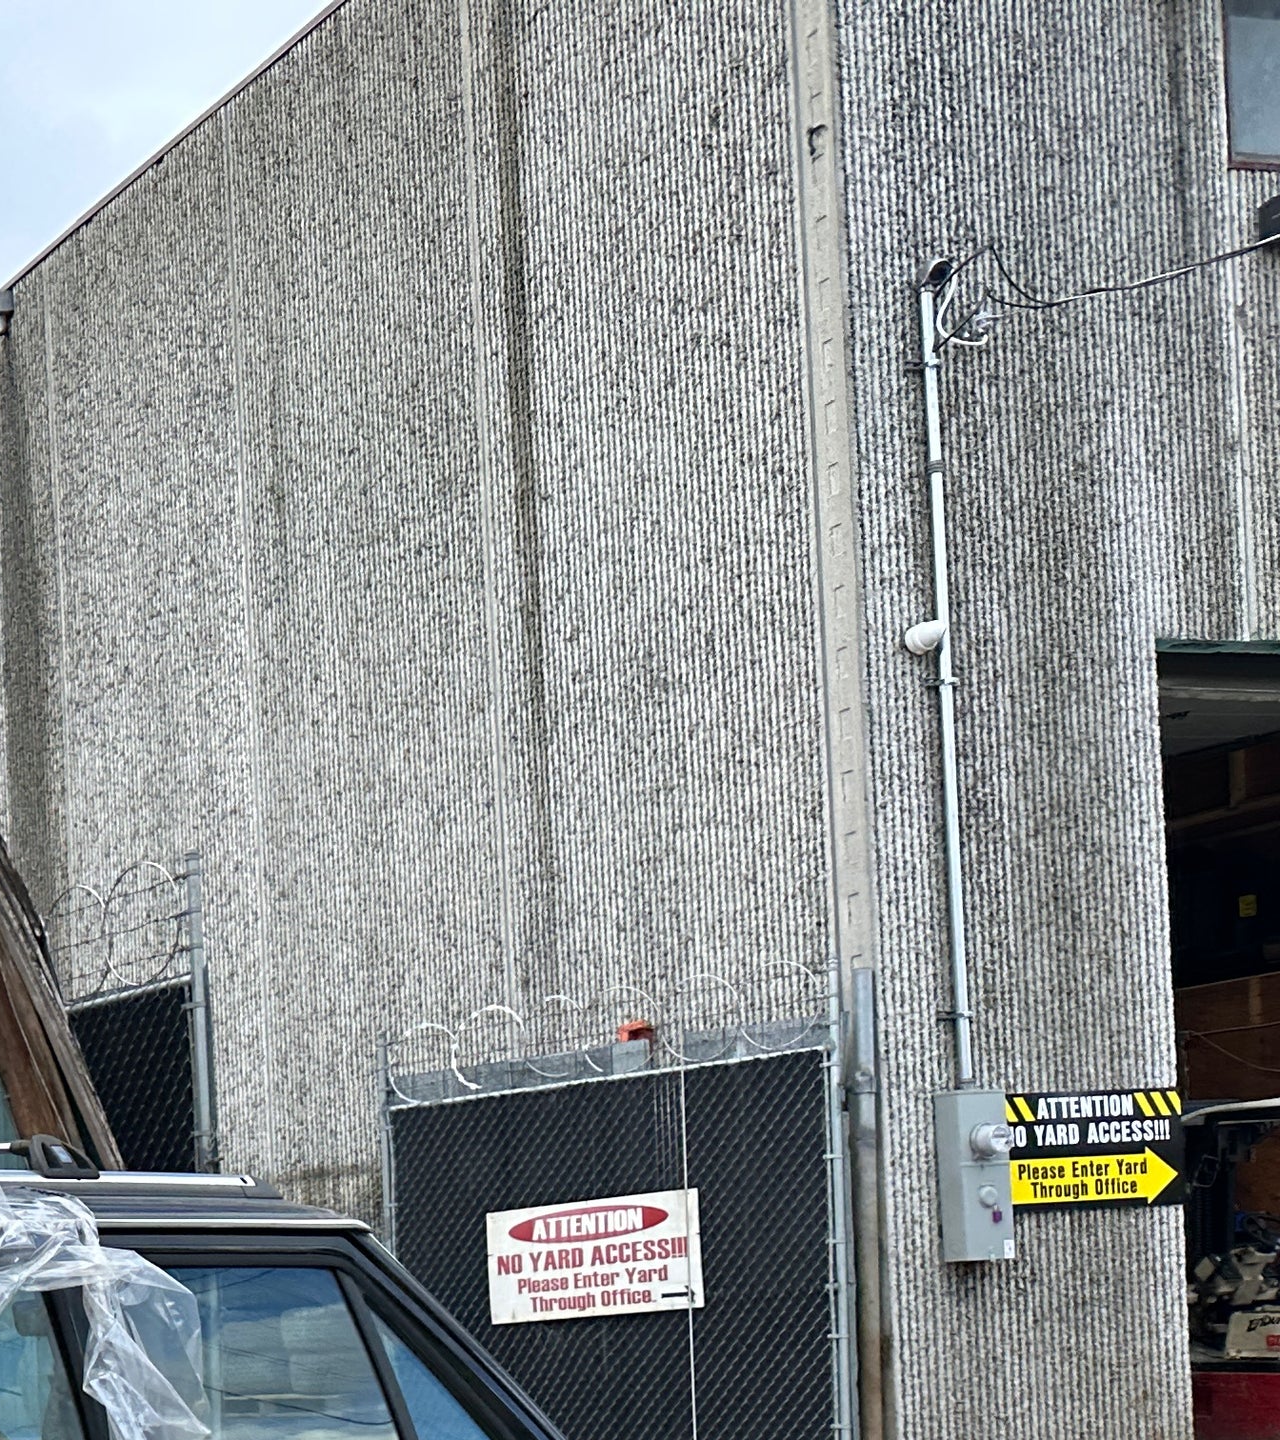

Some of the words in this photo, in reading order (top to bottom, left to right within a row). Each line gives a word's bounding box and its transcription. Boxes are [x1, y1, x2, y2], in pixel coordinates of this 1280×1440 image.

[1036, 1094, 1134, 1120] ATTENTION
[1034, 1123, 1080, 1147] YARD
[1087, 1118, 1171, 1145] ACCESS!!!
[1017, 1162, 1066, 1181] Please
[1072, 1160, 1110, 1178] Enter
[1116, 1158, 1147, 1176] Yard
[1030, 1180, 1089, 1199] Through
[1095, 1178, 1138, 1196] Office
[531, 1206, 644, 1242] ATTENTION
[497, 1254, 523, 1276] NO
[529, 1247, 584, 1273] YARD
[590, 1236, 689, 1267] ACCESS!!!
[517, 1276, 569, 1295] Please
[573, 1269, 620, 1289] Enter
[625, 1264, 669, 1285] Yard
[530, 1291, 596, 1314] Through
